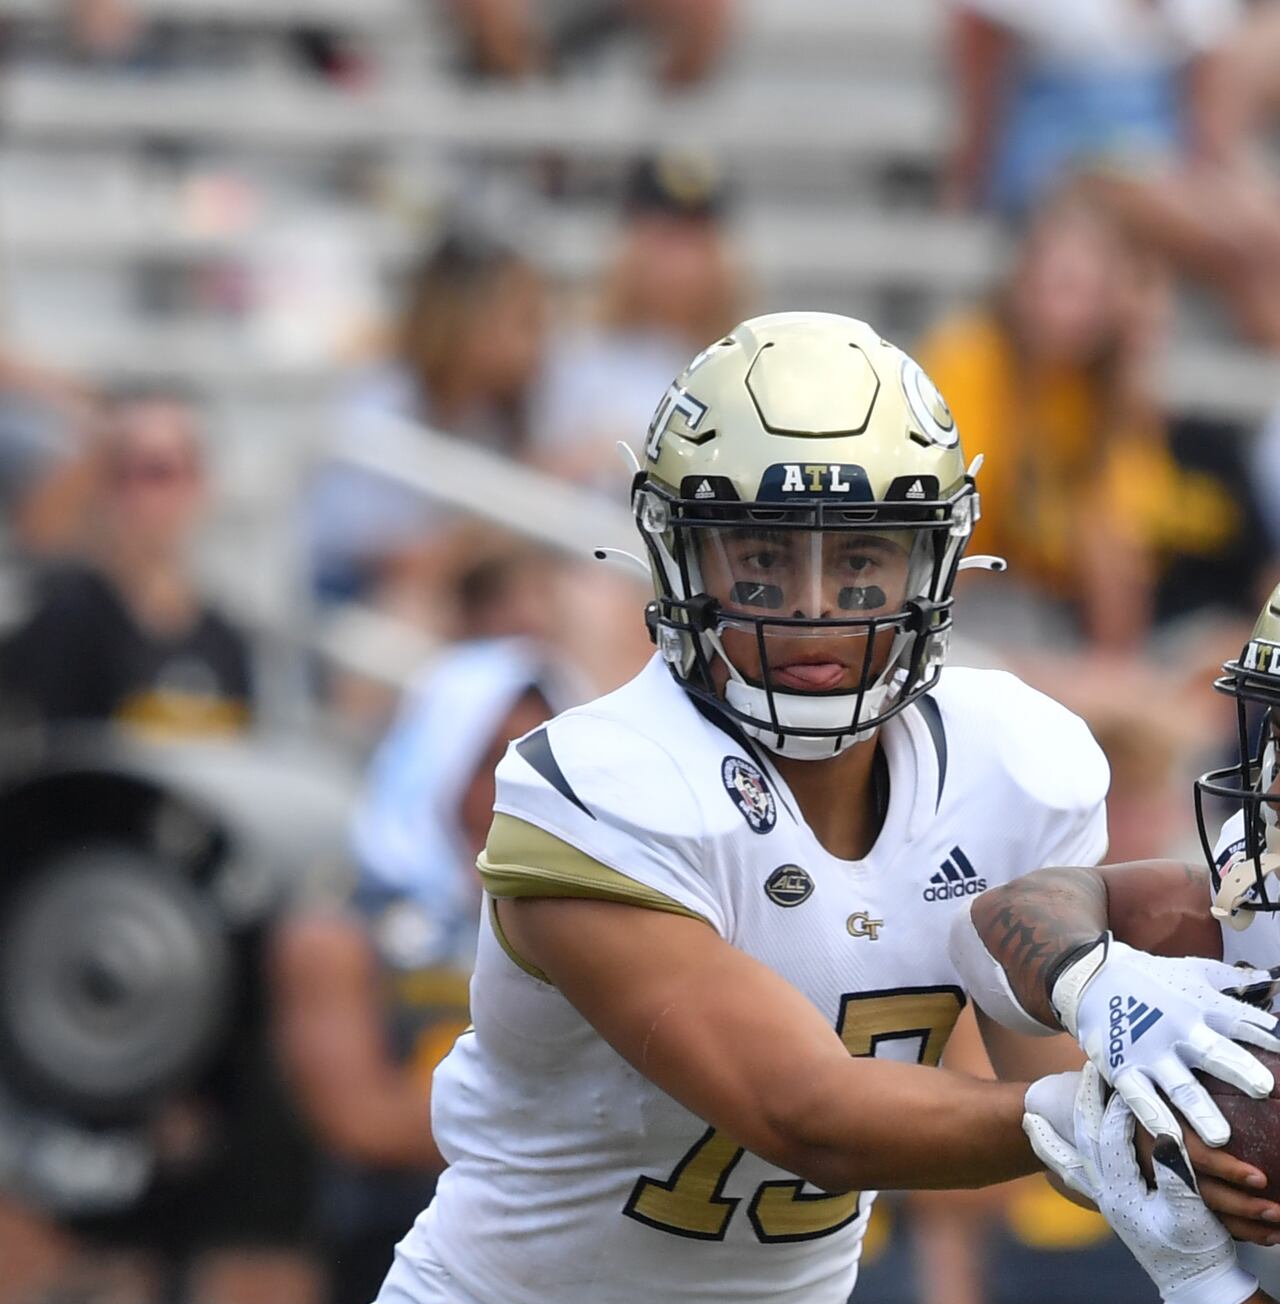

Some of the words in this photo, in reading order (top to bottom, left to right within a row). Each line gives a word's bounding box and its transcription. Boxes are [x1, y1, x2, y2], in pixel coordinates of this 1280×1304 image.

[781, 464, 850, 492] ATL
[771, 875, 808, 890] ACC
[923, 877, 988, 902] adidas
[846, 911, 884, 941] GT
[1109, 995, 1125, 1069] adidas
